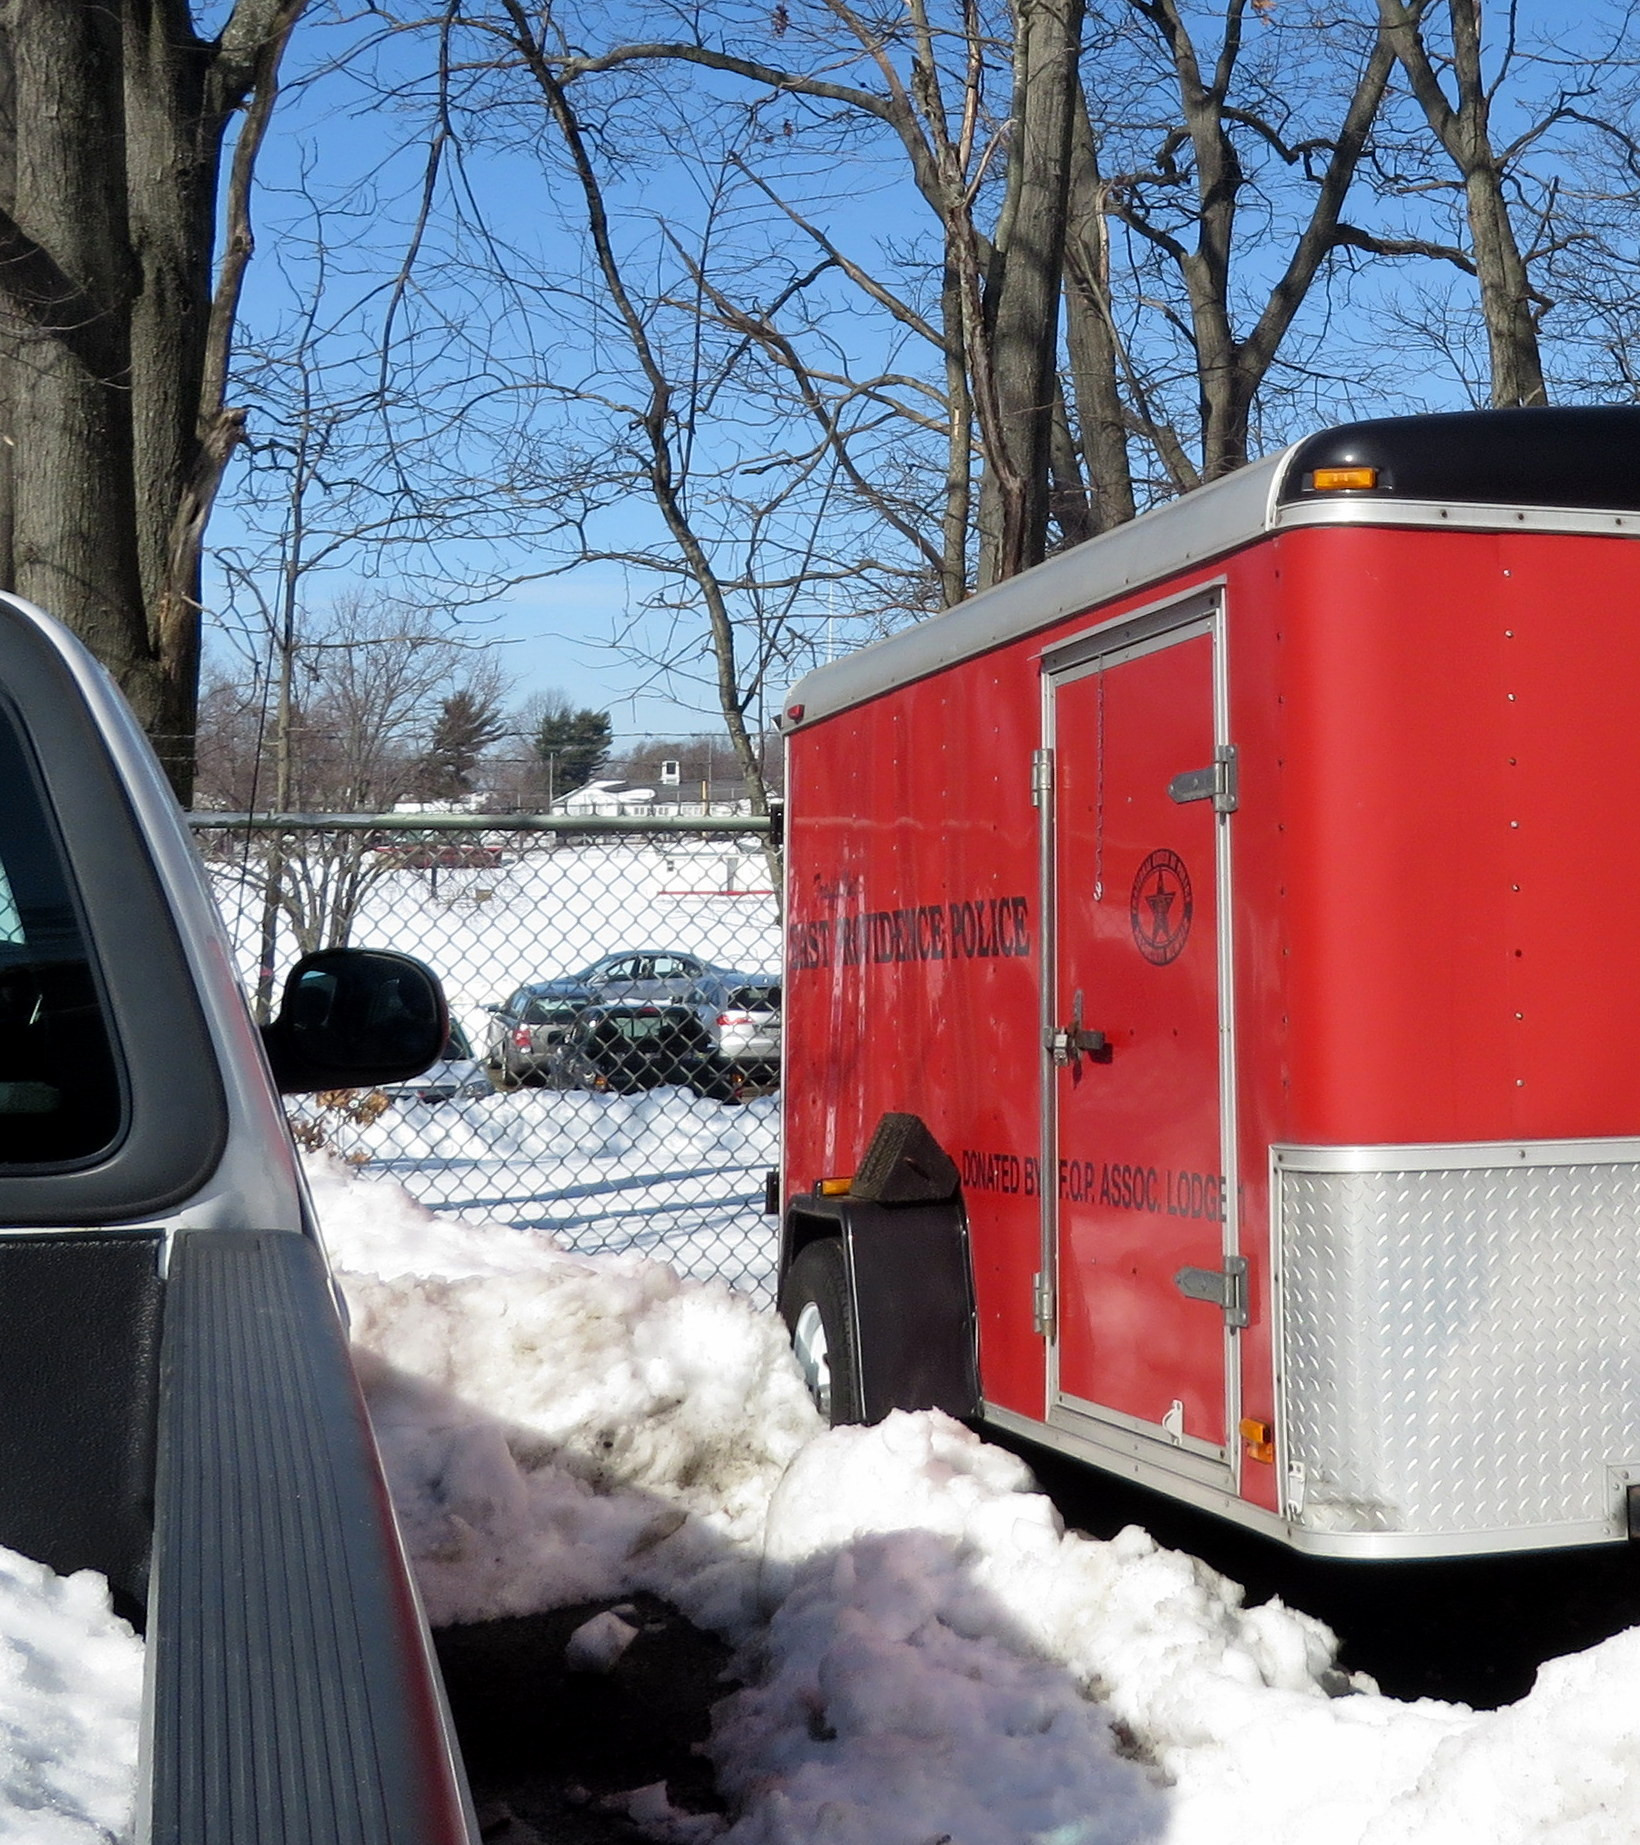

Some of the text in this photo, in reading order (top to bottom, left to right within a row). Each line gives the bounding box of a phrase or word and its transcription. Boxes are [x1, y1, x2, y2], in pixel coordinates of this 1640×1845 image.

[790, 920, 829, 968] EAST
[949, 896, 1030, 958] POLICE
[961, 1150, 1020, 1195] DONATED
[1024, 1157, 1041, 1196] BY
[1059, 1158, 1095, 1203] F.O.P.
[1100, 1163, 1160, 1214] ASSOC.
[1166, 1171, 1228, 1223] LODGE
